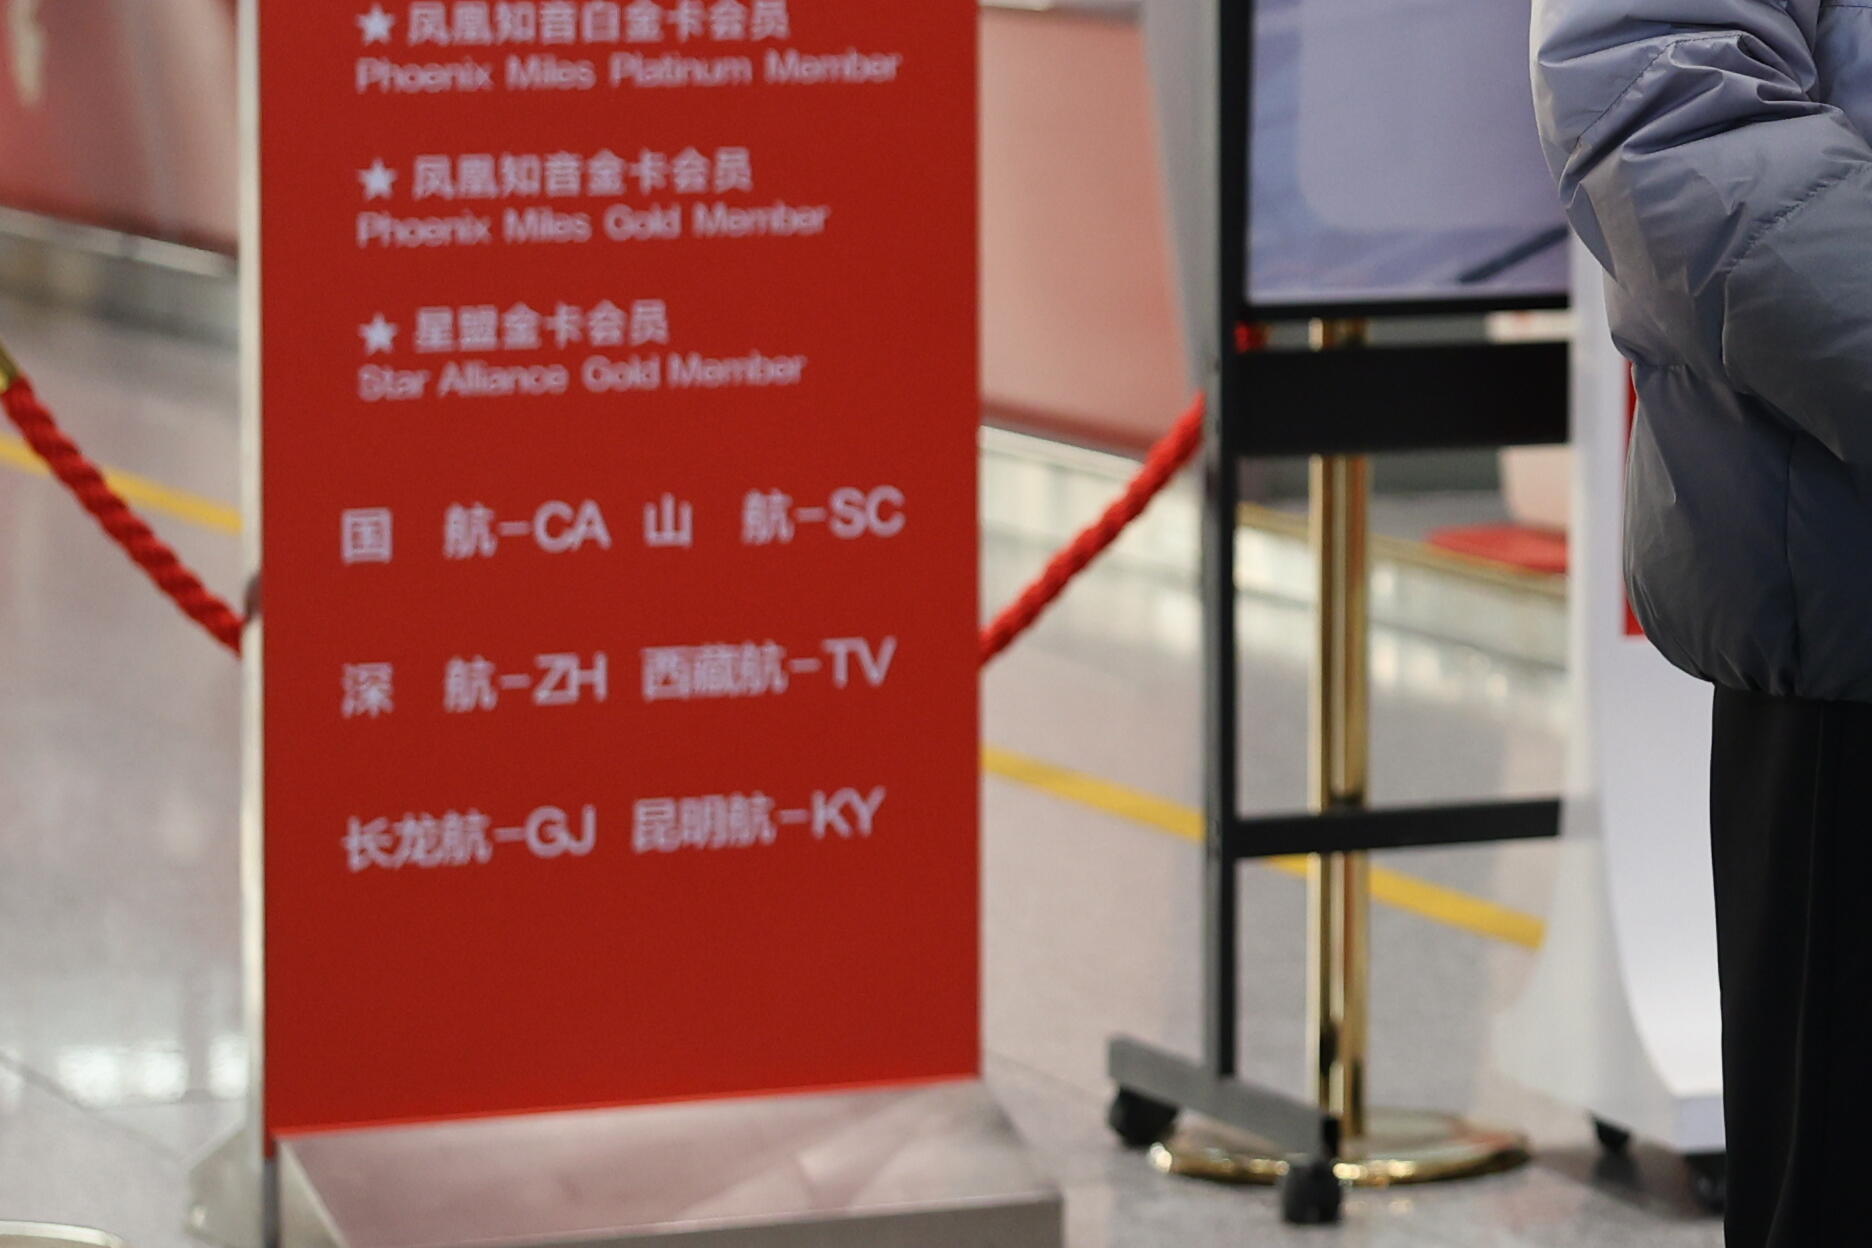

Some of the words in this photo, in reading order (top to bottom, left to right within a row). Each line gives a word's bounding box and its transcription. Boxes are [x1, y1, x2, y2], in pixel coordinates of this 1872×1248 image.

[355, 56, 493, 94] Phoenix
[505, 54, 596, 90] Miles
[609, 50, 752, 89] Platinum
[764, 48, 902, 85] Member
[412, 147, 752, 200] 凤凰知音金卡会员
[356, 210, 491, 248] Phoenix
[503, 207, 592, 244] Miles
[603, 202, 682, 241] Gold
[692, 200, 829, 238] Member
[413, 299, 669, 353] 星盟金卡会员
[358, 362, 430, 402] Star
[437, 359, 569, 397] Alliance
[581, 354, 661, 392] Gold
[667, 350, 807, 388] Member
[340, 507, 393, 564] 国
[443, 499, 612, 560] 航-CA
[643, 492, 693, 548] 山
[741, 485, 905, 545] 航-SC
[341, 662, 394, 718] 深
[641, 636, 896, 702] 西藏航-TV
[342, 805, 597, 873] 长龙航-GJ
[632, 787, 886, 854] 昆明航-KY
